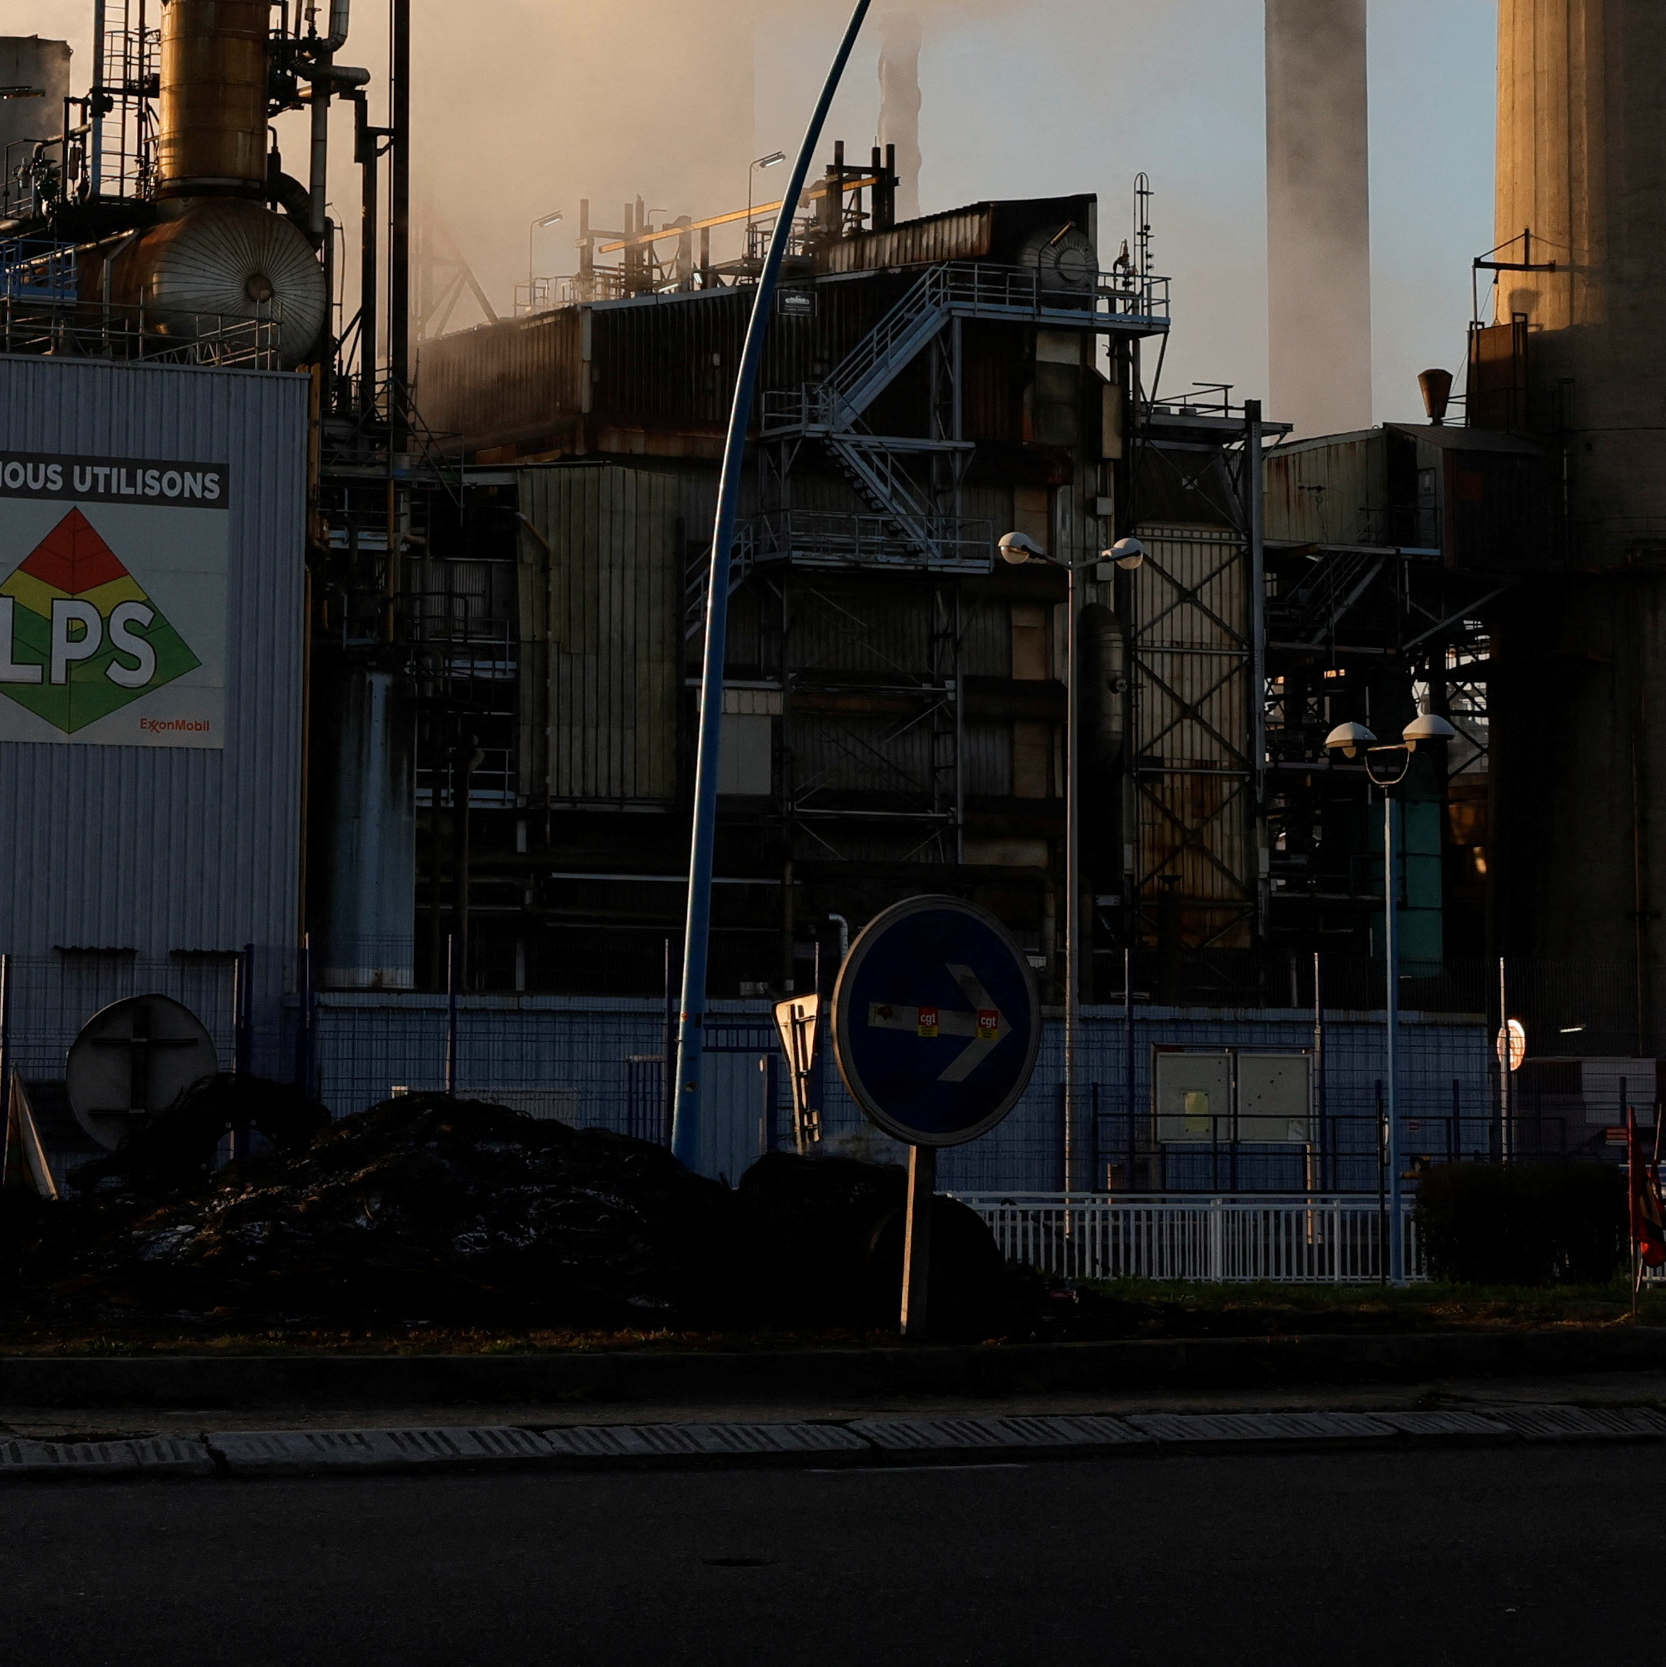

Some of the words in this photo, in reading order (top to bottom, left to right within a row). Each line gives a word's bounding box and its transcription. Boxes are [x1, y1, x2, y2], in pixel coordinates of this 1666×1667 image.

[73, 465, 220, 500] UTILISONS
[139, 718, 210, 733] ExxonMobil
[920, 1013, 936, 1026] cgt
[980, 1016, 997, 1029] cgt
